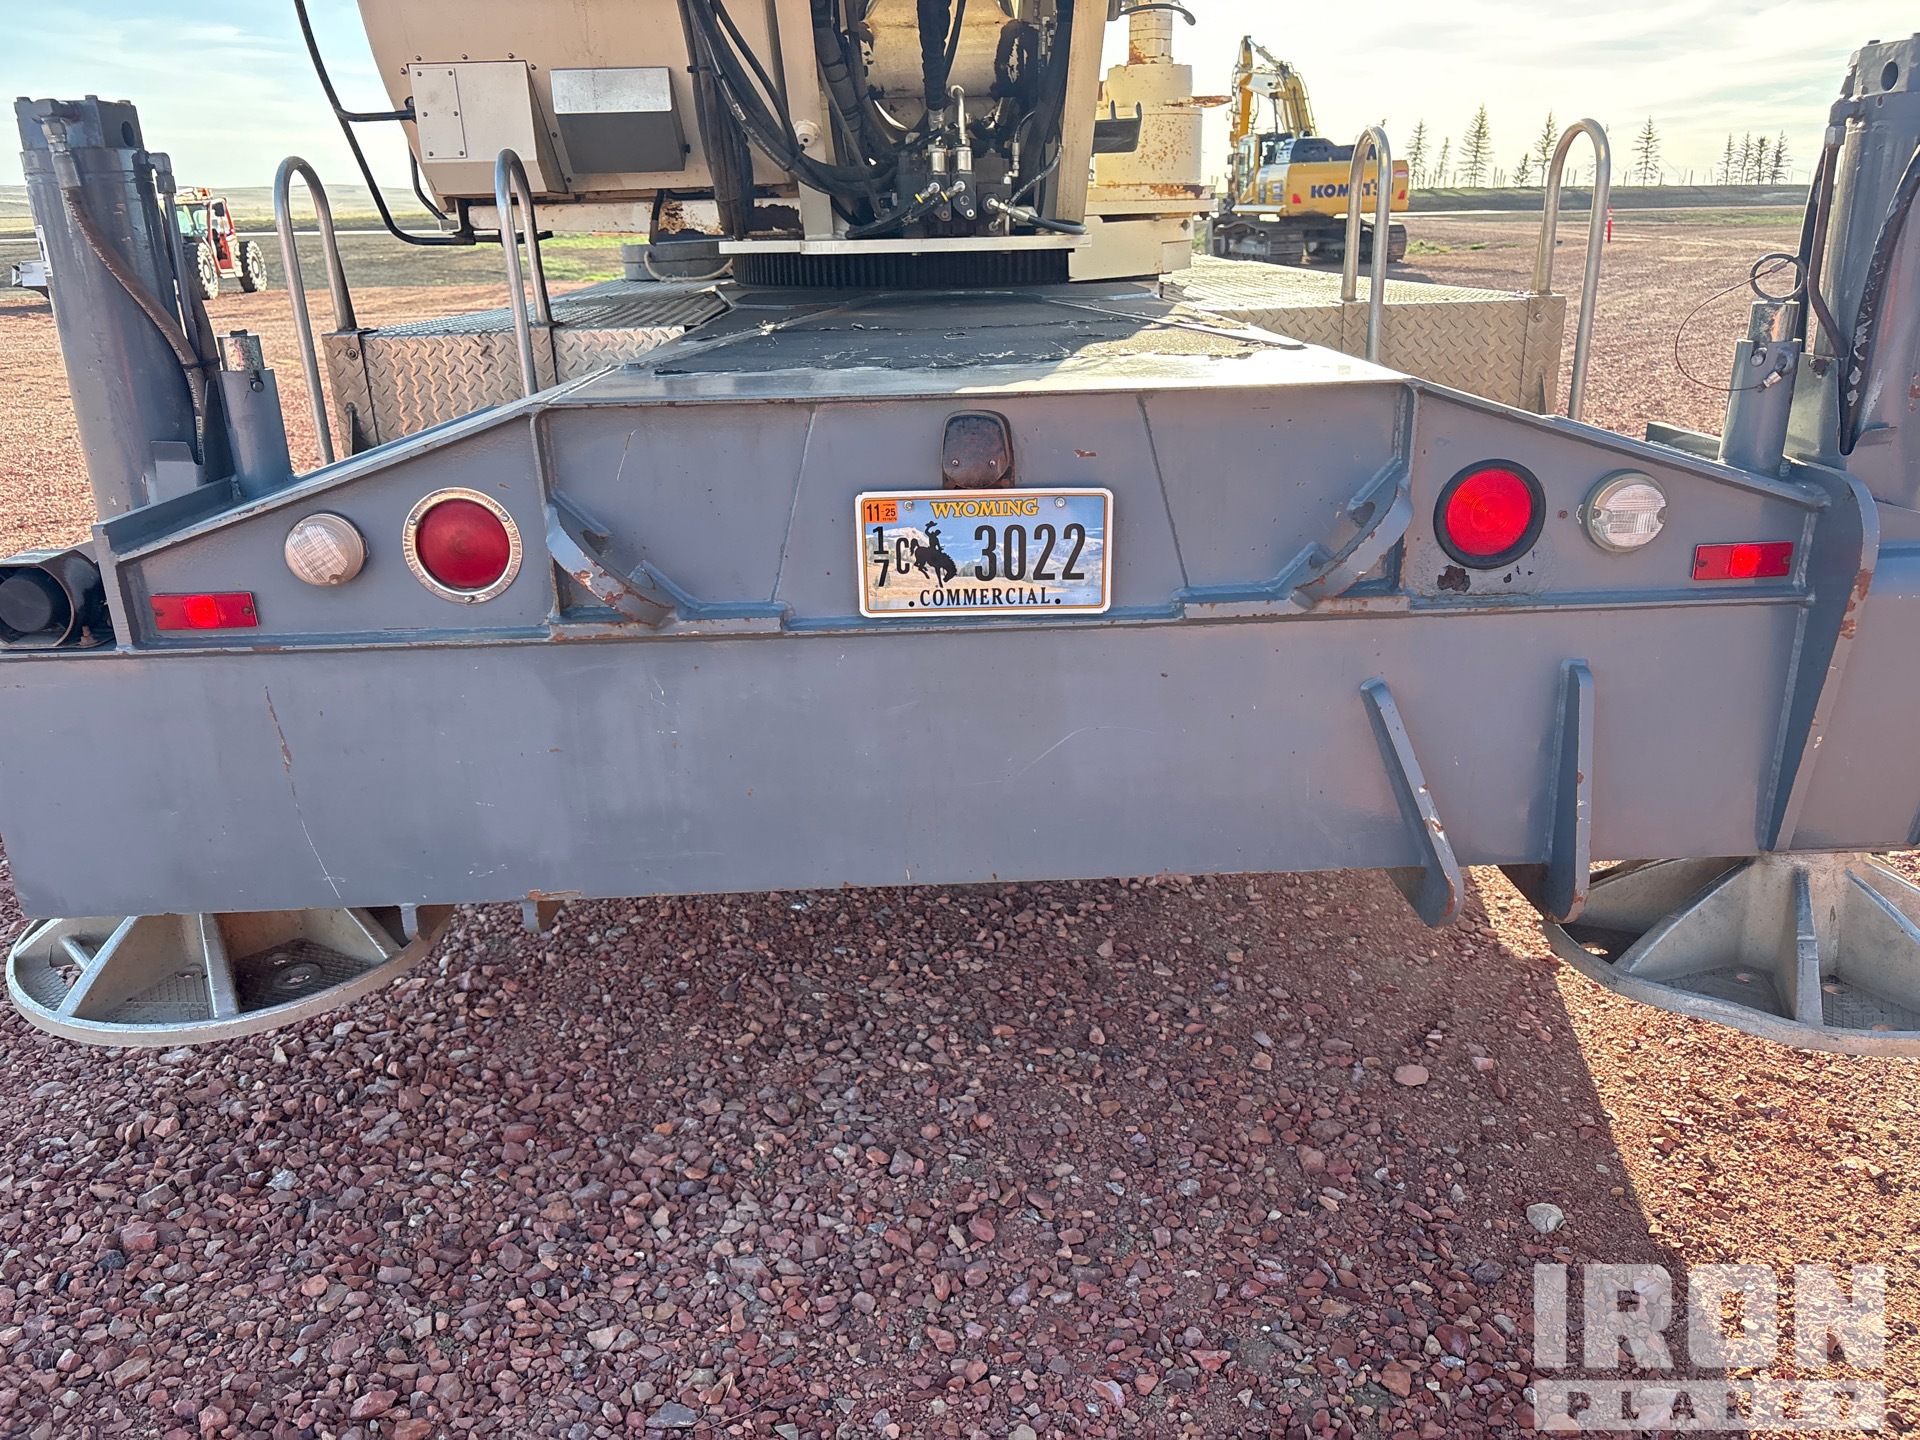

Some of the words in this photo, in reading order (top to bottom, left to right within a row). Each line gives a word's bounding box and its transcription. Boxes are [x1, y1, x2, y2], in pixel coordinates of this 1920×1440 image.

[930, 498, 1039, 519] WYOMING
[895, 537, 910, 575] C
[974, 523, 1086, 581] 3022
[920, 587, 1051, 607] COMMERCIAL
